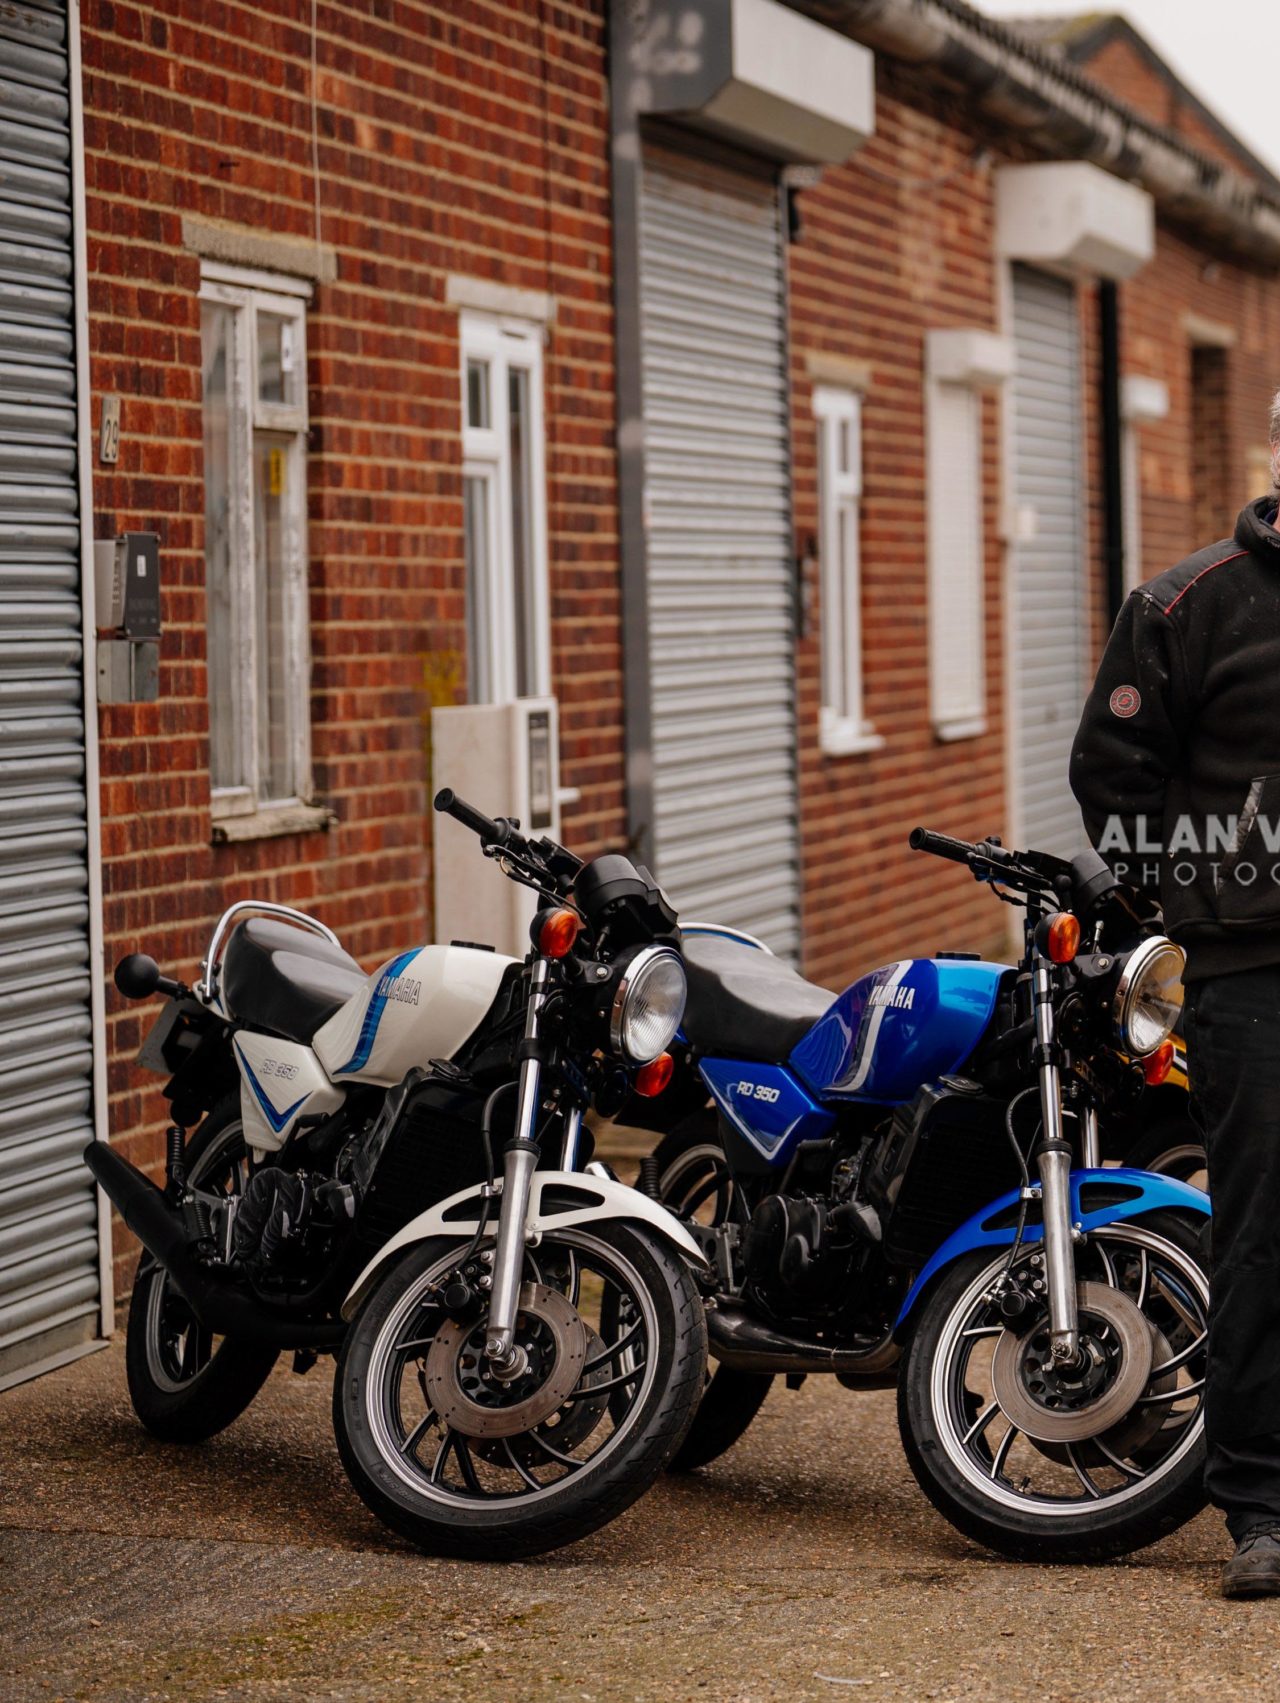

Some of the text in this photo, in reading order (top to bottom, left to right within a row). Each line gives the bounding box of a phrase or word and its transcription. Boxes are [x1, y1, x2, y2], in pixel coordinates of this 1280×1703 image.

[104, 418, 118, 459] 29
[377, 975, 421, 1006] YAMAHA
[868, 985, 916, 1010] YAMAHA
[736, 1080, 780, 1103] RD 350
